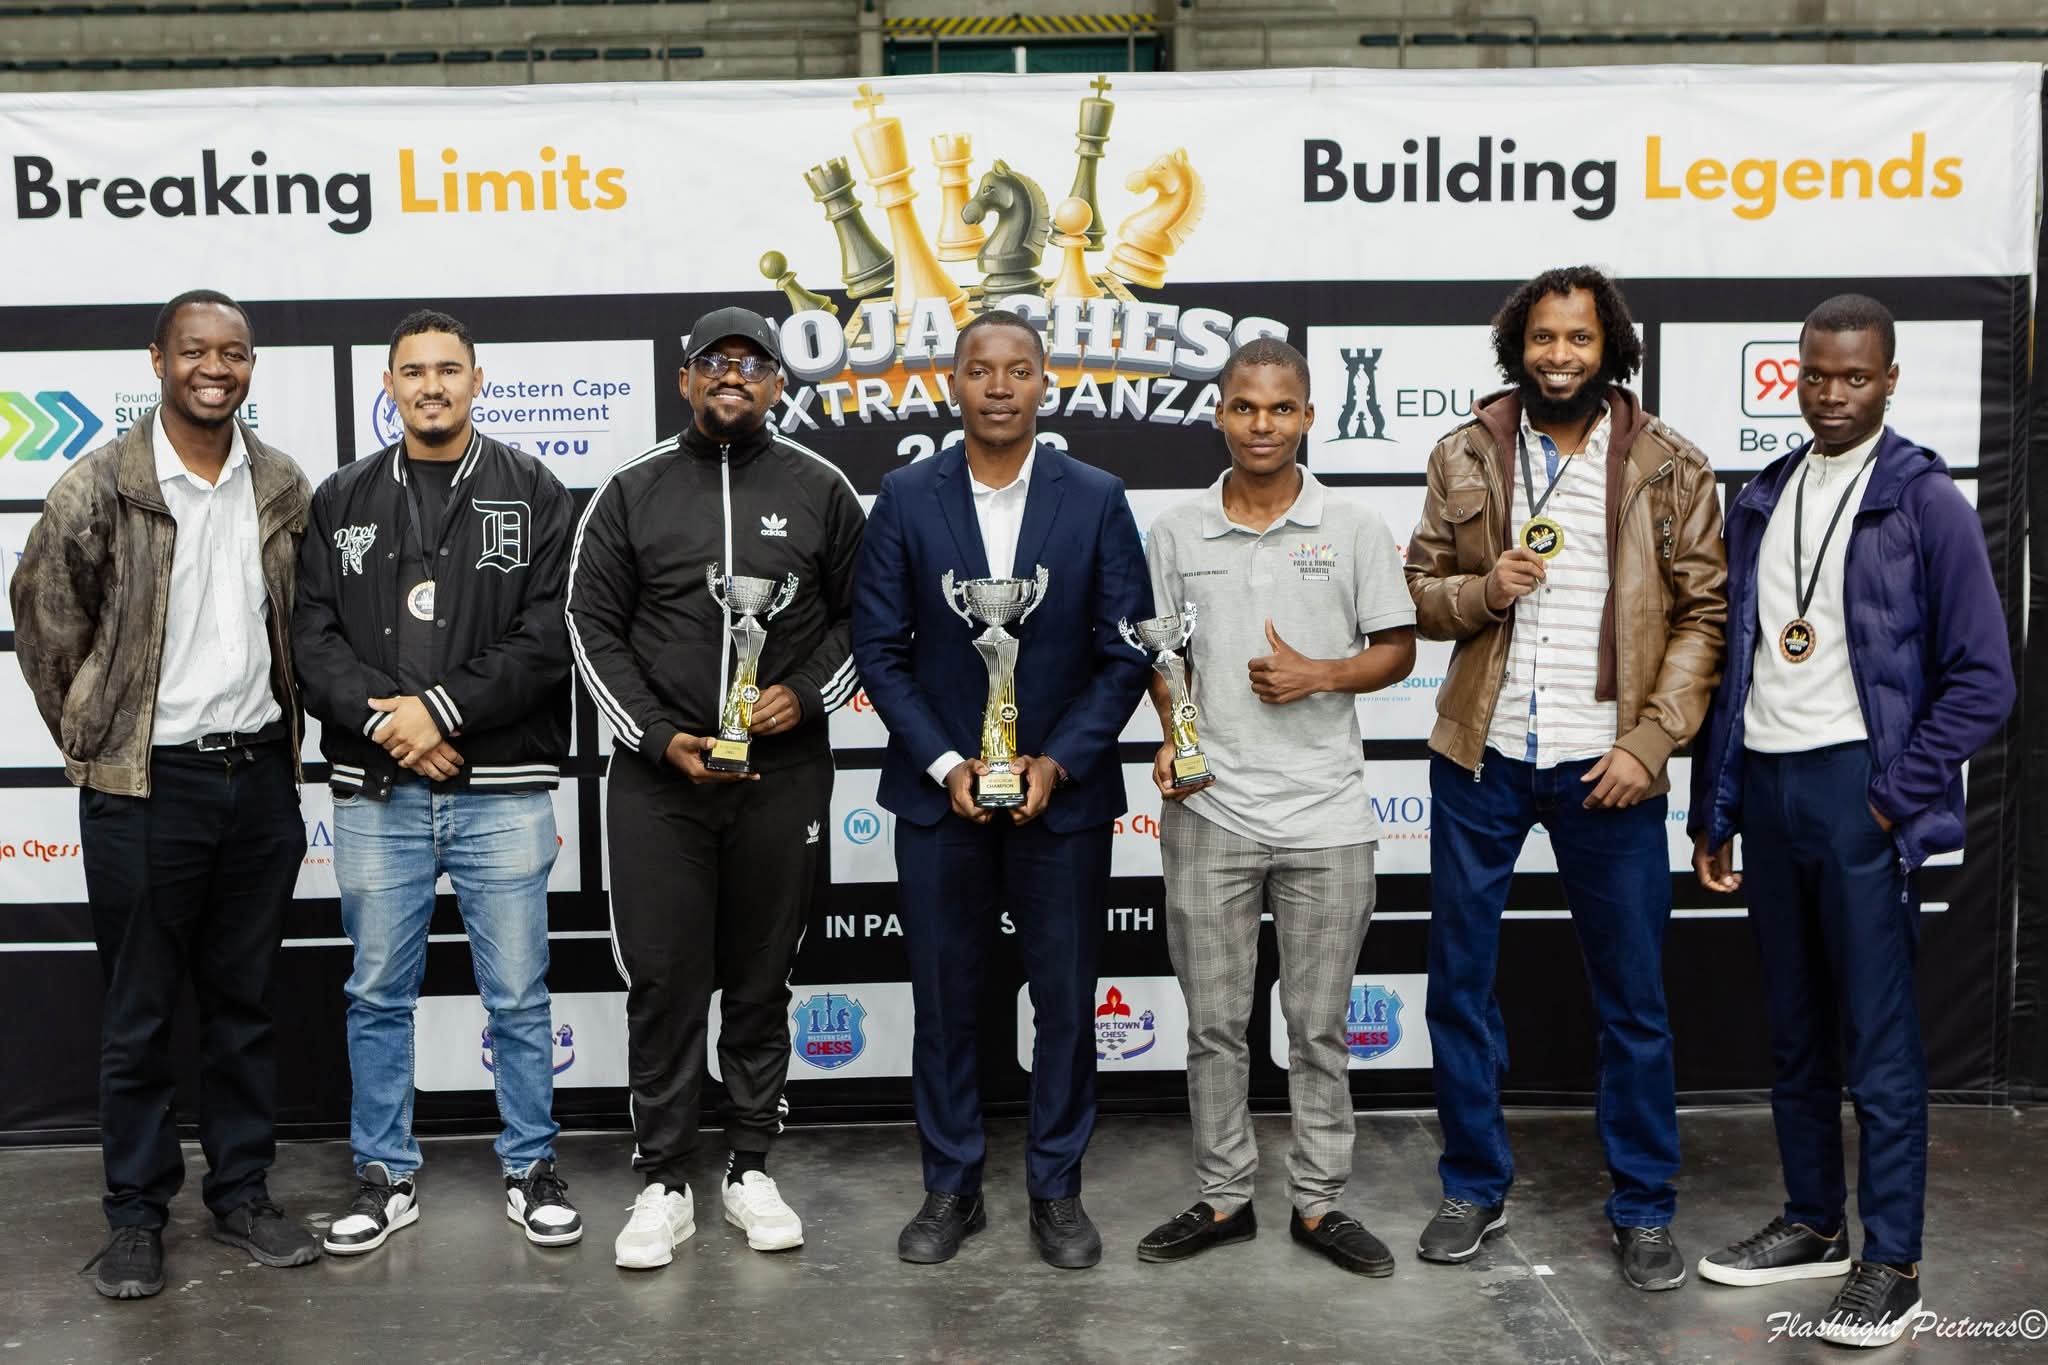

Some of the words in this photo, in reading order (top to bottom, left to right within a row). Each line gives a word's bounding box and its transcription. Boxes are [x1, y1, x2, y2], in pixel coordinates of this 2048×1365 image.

[1303, 136, 1617, 221] Building
[1645, 132, 1964, 220] Legends
[13, 149, 372, 235] Breaking
[399, 146, 628, 213] Limits
[680, 297, 960, 385] OJA
[573, 379, 631, 400] Cape
[470, 404, 610, 423] Government
[536, 439, 589, 456] YOU
[1740, 428, 1777, 452] Be
[22, 839, 81, 862] Chess
[825, 914, 855, 939] IN
[1107, 907, 1154, 932] ITH
[1095, 1022, 1111, 1030] APE
[806, 1041, 852, 1055] CHESS
[1344, 1032, 1389, 1045] CHESS
